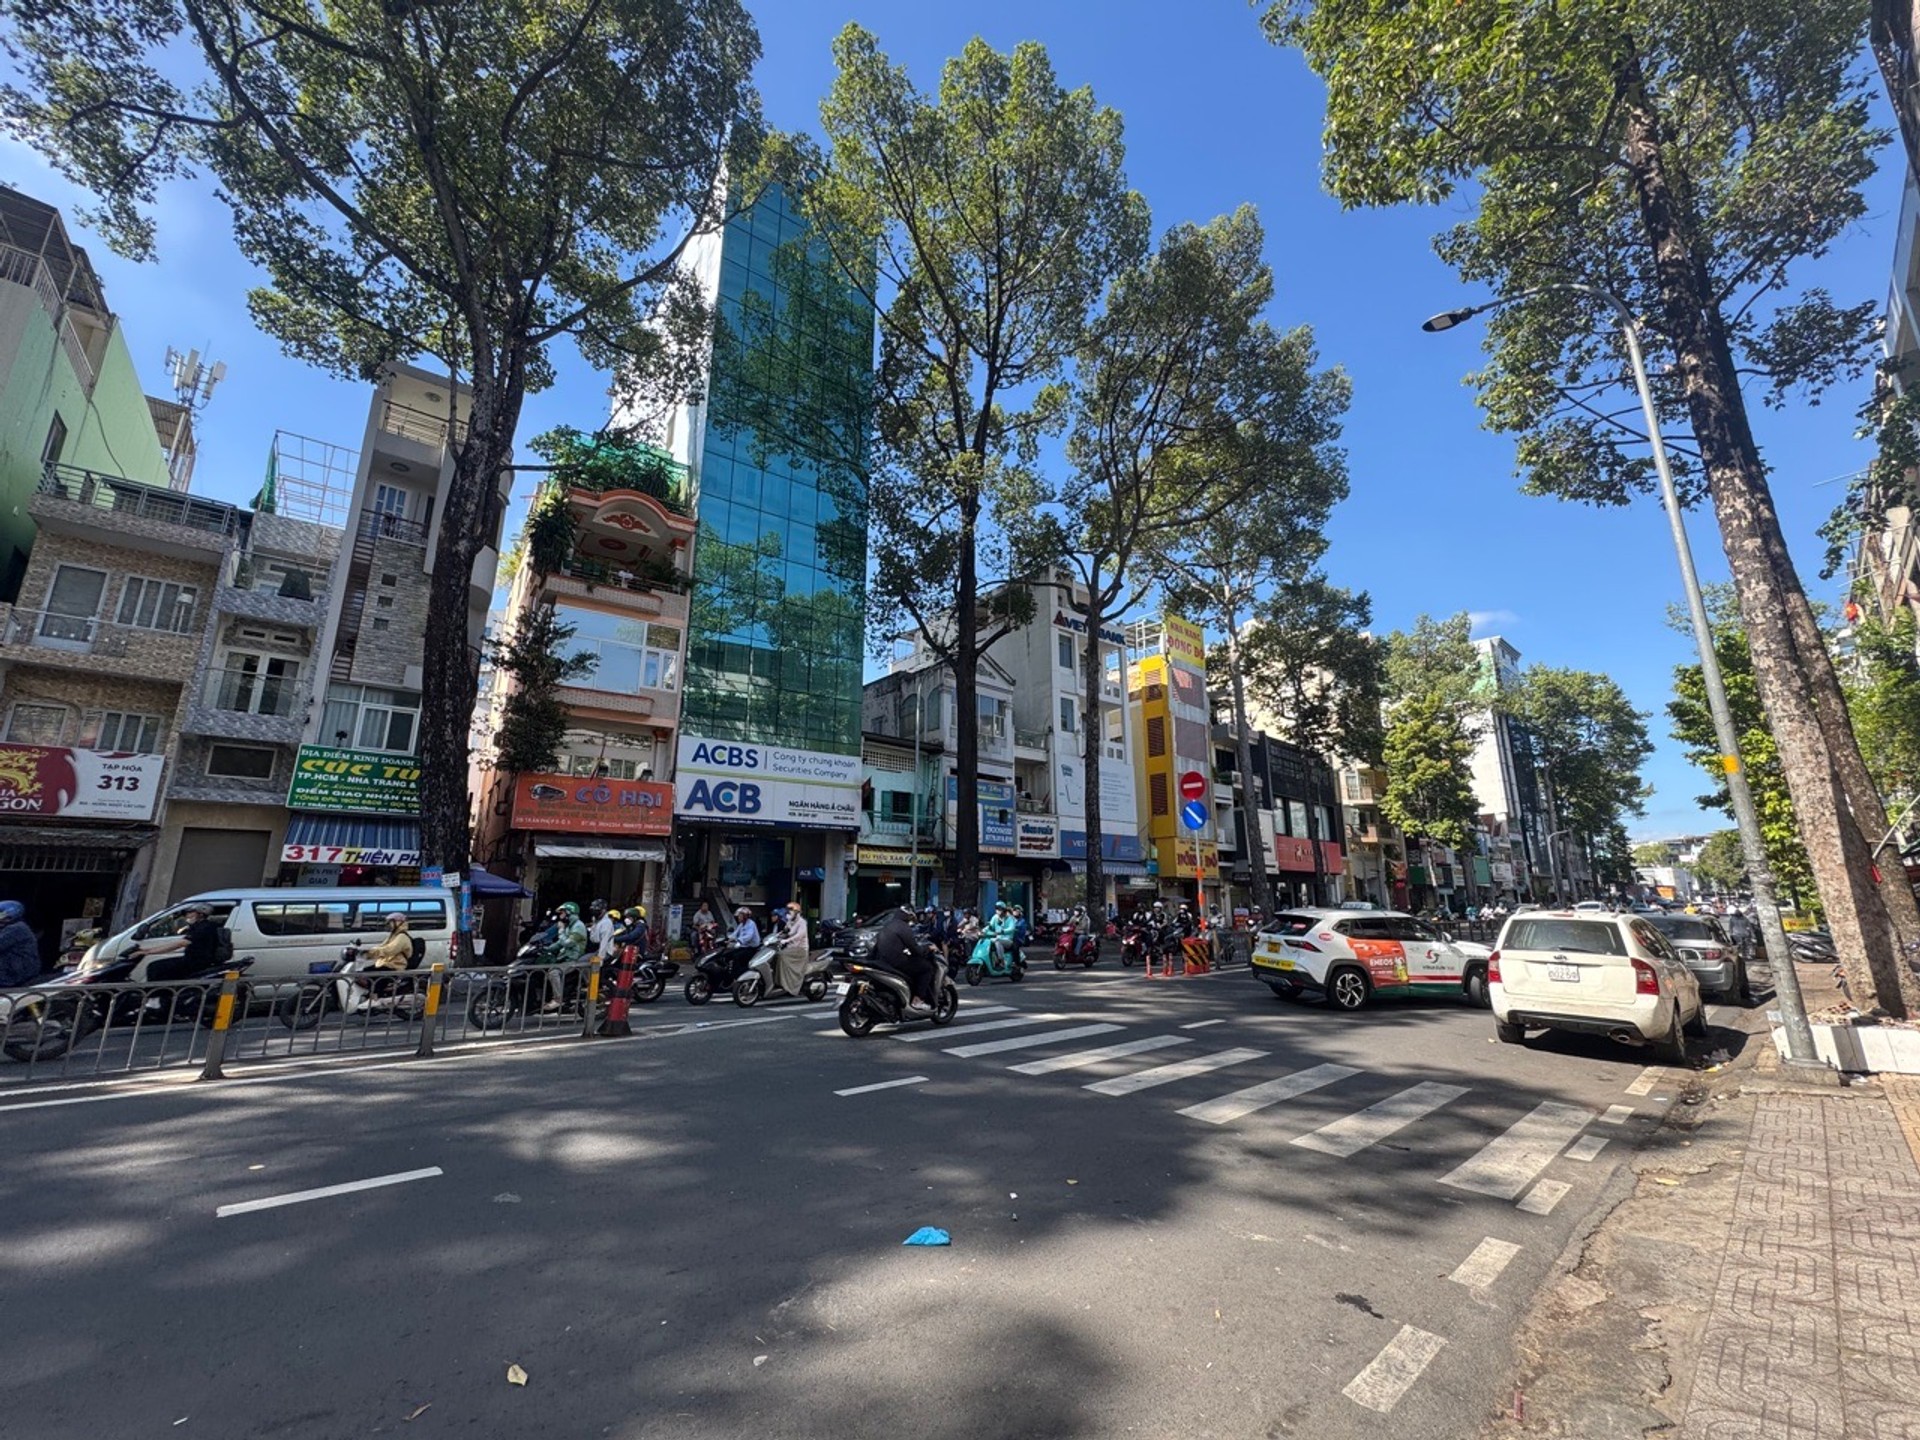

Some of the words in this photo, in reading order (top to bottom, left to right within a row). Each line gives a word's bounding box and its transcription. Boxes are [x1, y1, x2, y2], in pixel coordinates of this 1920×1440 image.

[353, 754, 379, 763] KINH
[381, 757, 415, 766] DOANH
[692, 743, 759, 768] ACBS
[799, 755, 807, 764] ty
[297, 771, 339, 781] TP.HCM
[347, 776, 370, 785] NHA
[372, 779, 407, 788] TRANG
[773, 763, 812, 775] Securities
[814, 768, 848, 780] Company
[97, 775, 140, 791] 313
[332, 790, 362, 798] GIAO
[576, 783, 611, 804] CÔ
[618, 789, 662, 808] HAI
[684, 779, 762, 814] ACB
[788, 800, 809, 808] NGÂN
[810, 801, 830, 809] HÀNG
[837, 804, 855, 812] CHÂU
[285, 845, 343, 863] 317
[308, 877, 328, 885] GIAO
[1370, 958, 1394, 966] ENEOS
